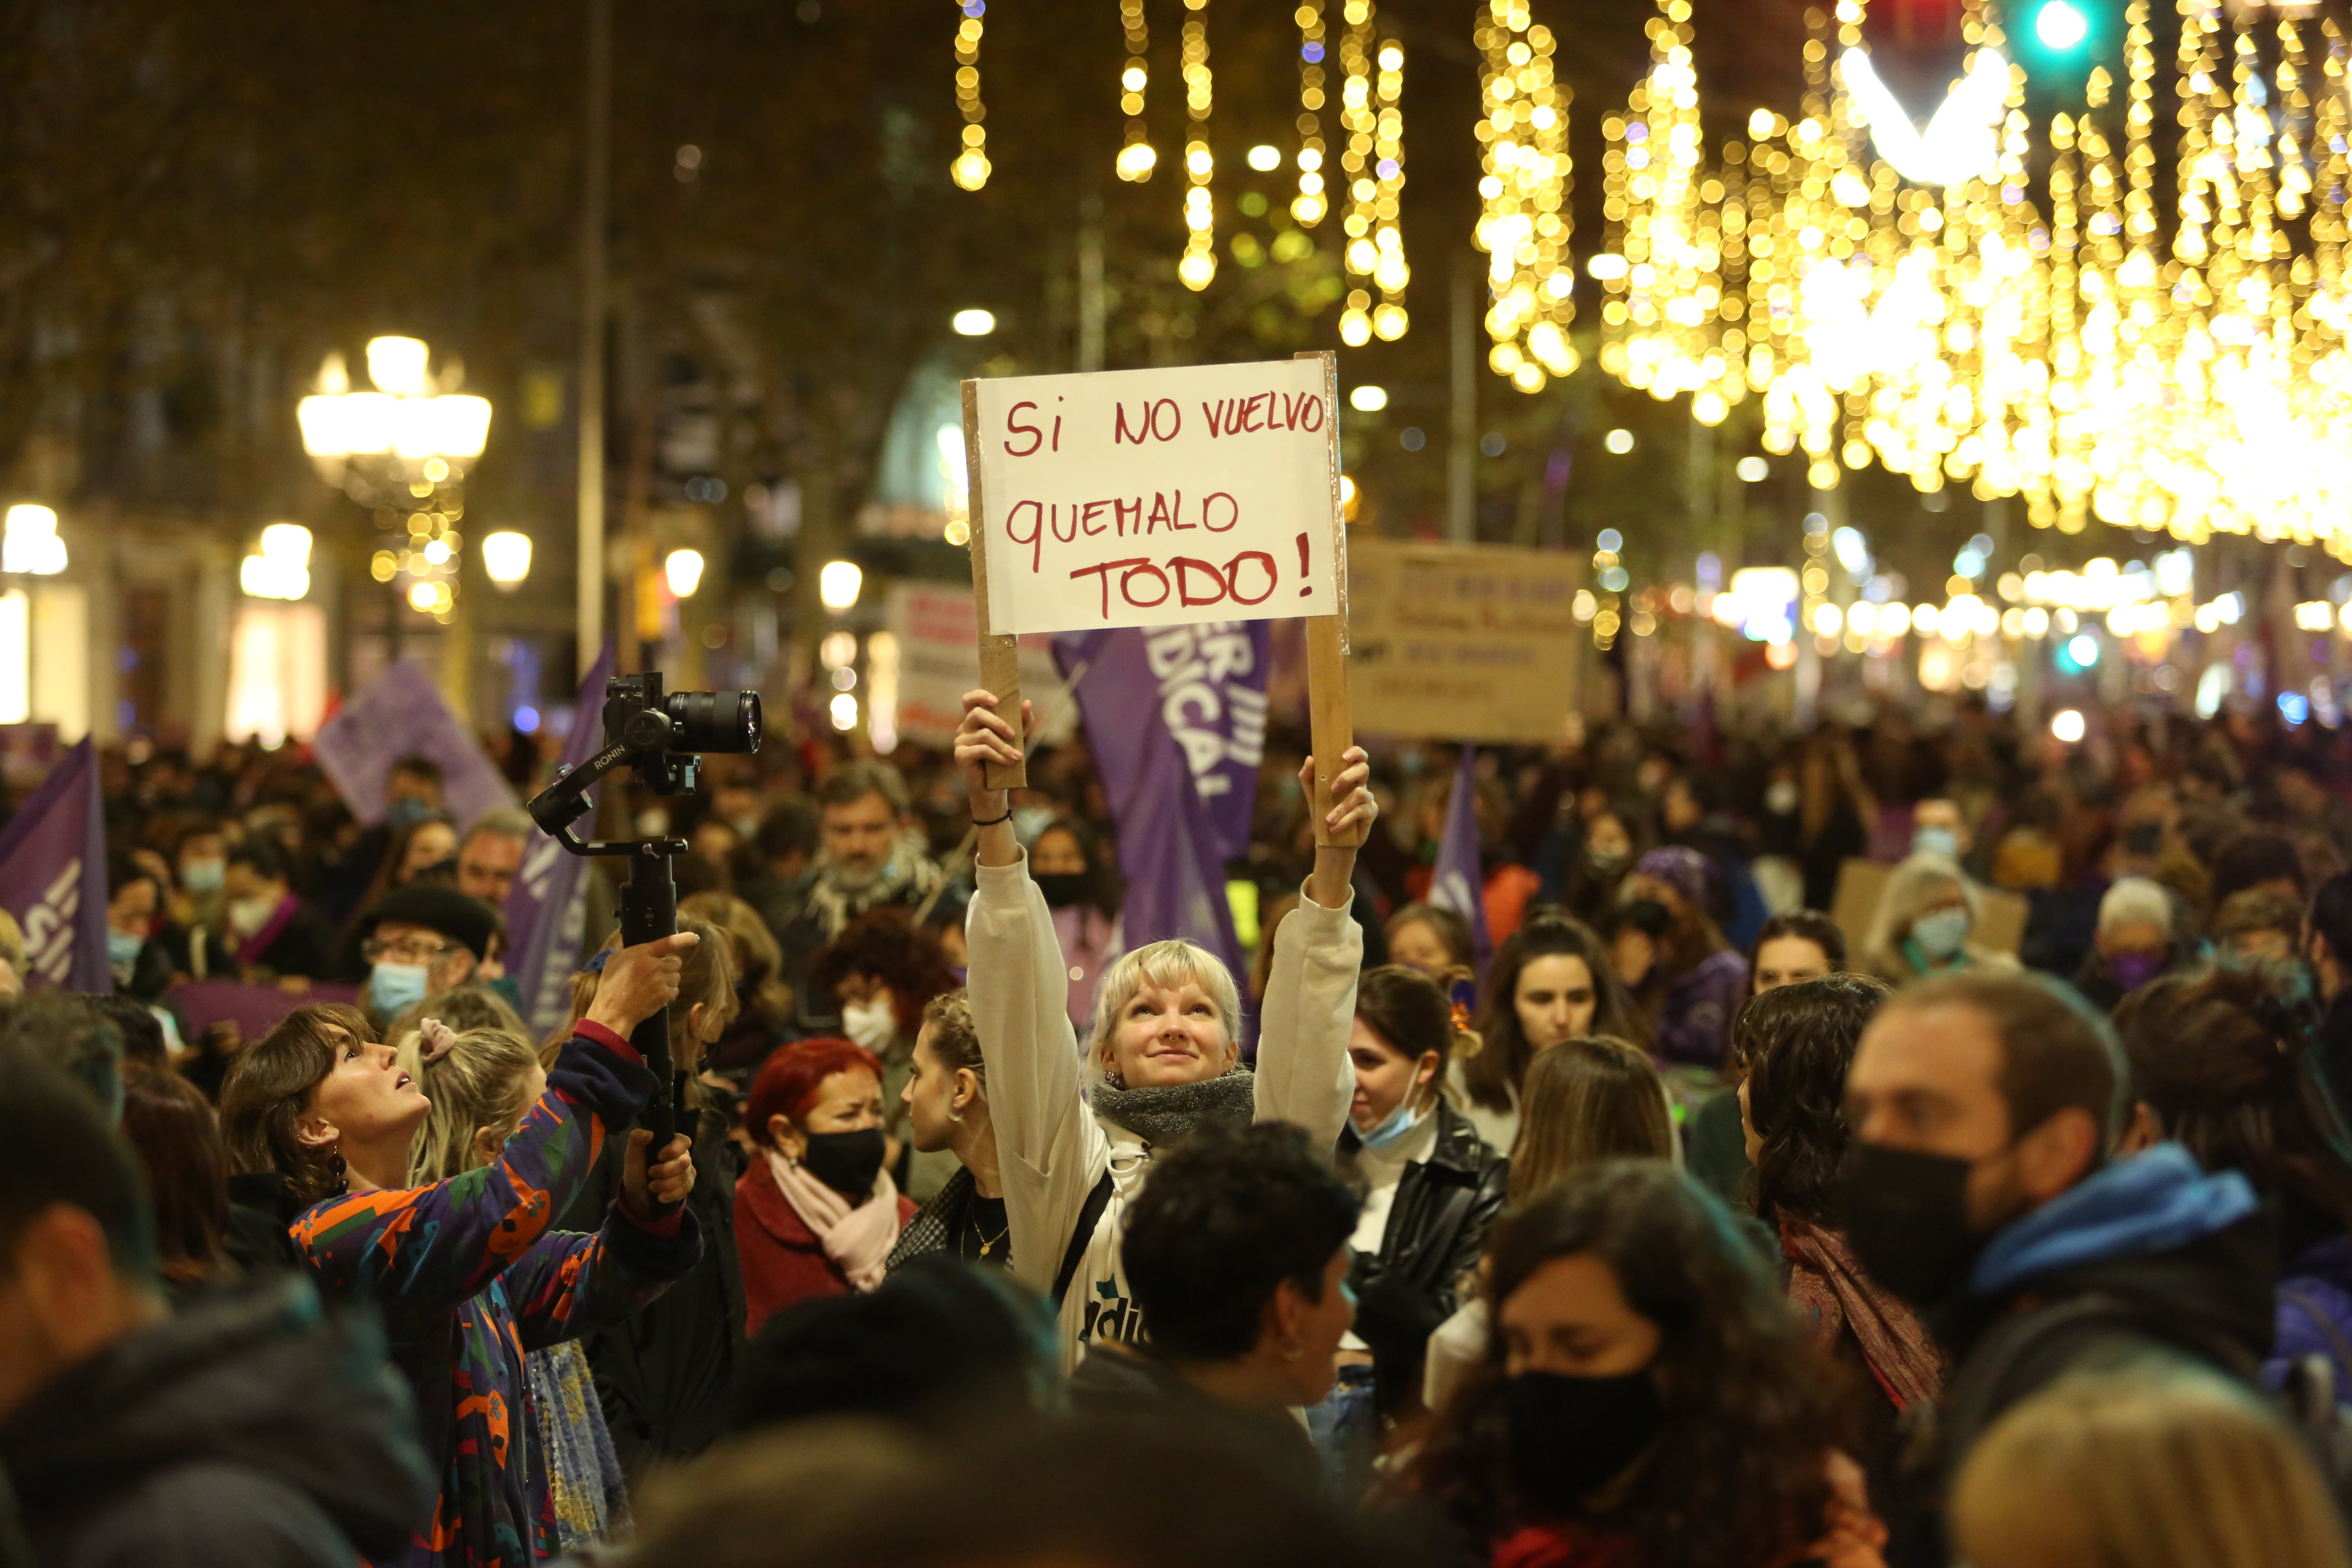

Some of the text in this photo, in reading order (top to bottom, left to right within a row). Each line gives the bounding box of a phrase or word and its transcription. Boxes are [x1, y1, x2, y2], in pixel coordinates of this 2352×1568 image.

[1115, 397, 1182, 445] NO
[1202, 391, 1325, 439] VUELVO
[594, 744, 626, 770] RONIN
